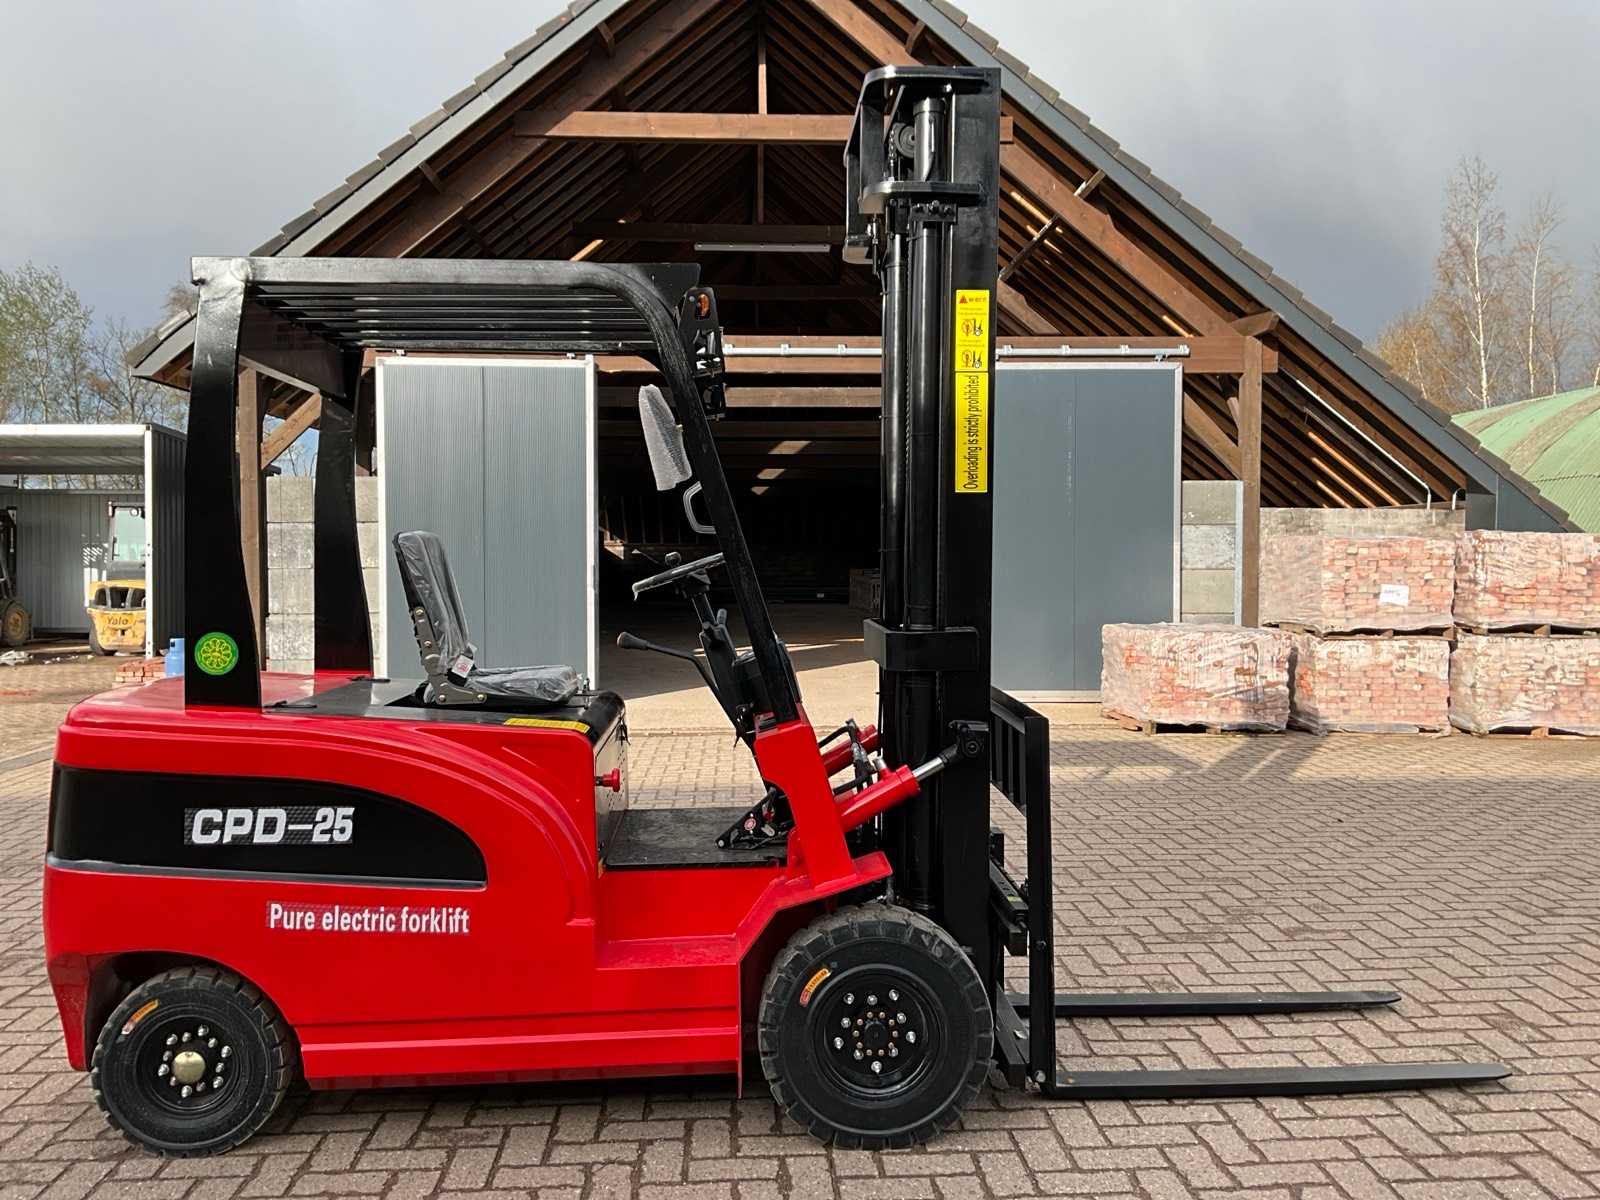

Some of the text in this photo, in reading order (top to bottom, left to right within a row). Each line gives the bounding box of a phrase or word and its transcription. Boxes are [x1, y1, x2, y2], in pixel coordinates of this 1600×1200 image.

[963, 374, 982, 412] prohibited
[963, 413, 982, 438] strictly
[963, 446, 982, 489] Overloading
[191, 807, 355, 844] CPD-25
[270, 903, 469, 933] Pure electric forklift
